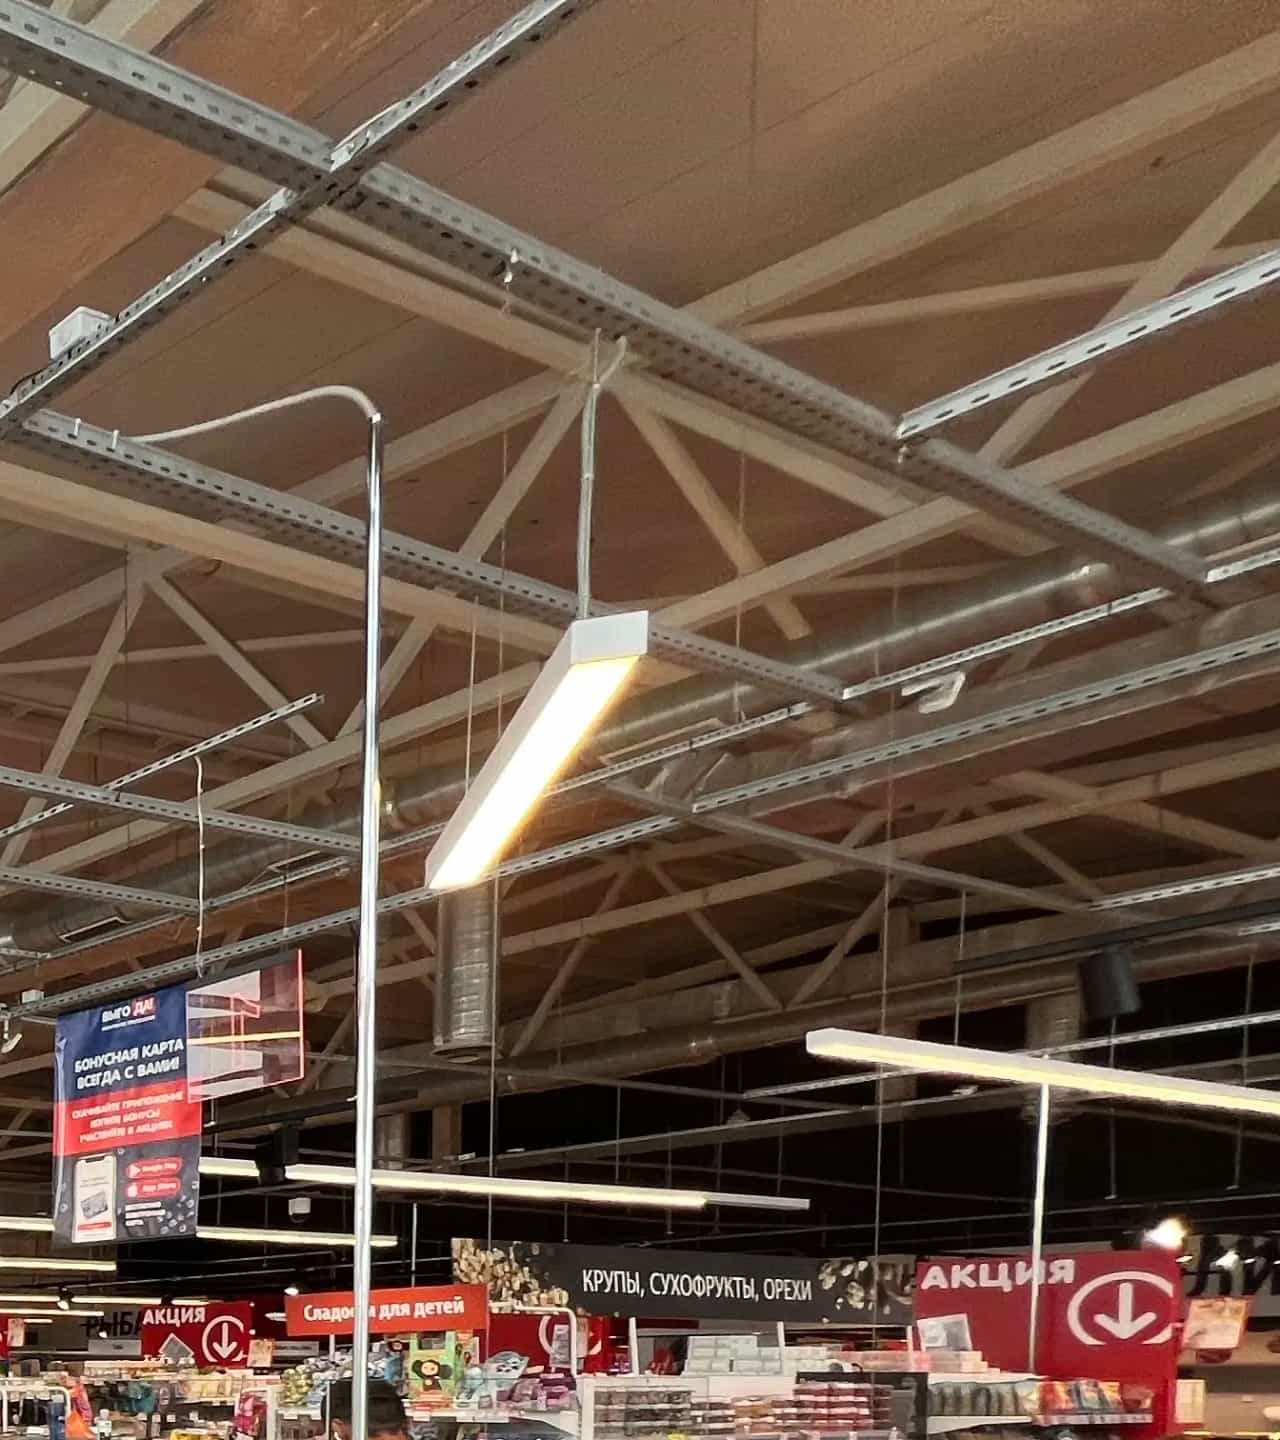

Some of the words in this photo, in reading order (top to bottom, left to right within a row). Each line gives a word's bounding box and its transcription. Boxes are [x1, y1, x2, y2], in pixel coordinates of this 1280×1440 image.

[75, 1047, 138, 1073] БОНУСНАЯ
[142, 1038, 184, 1058] КАРТА
[77, 1071, 121, 1090] ВСЕГДА
[124, 1066, 134, 1079] С
[137, 1056, 180, 1077] ВАМИ!
[583, 1269, 645, 1299] КРУПЫ,
[650, 1272, 759, 1302] СУХОФРУКТЫ,
[764, 1278, 812, 1301] ОРЕХИ
[920, 1259, 1076, 1293] АКЦИЯ
[143, 1307, 206, 1328] АКЦИЯ
[304, 1304, 375, 1322] Сладоси
[379, 1303, 410, 1320] для
[414, 1297, 464, 1317] детей
